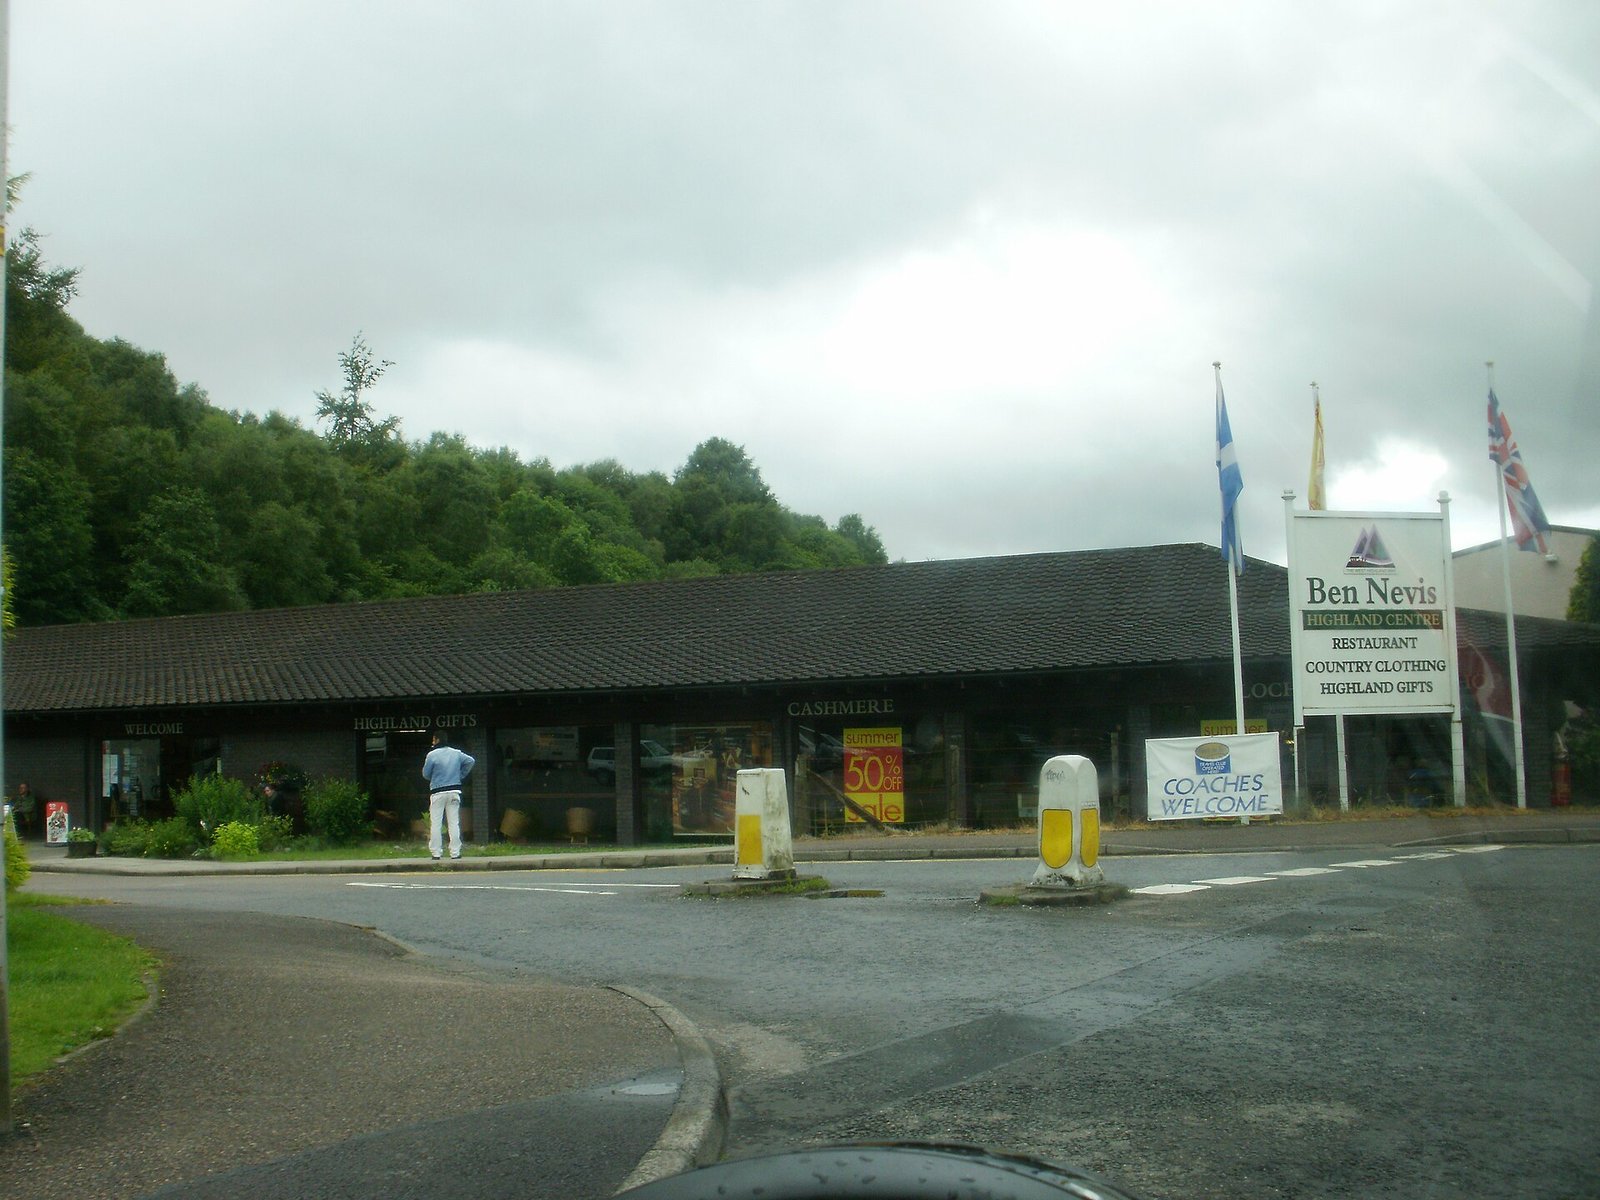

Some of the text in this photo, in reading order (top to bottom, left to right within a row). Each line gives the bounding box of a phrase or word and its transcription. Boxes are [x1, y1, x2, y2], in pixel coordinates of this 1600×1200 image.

[1306, 577, 1437, 605] Ben Nevis
[1307, 613, 1440, 626] HIGHLAND CENTRE
[1332, 637, 1418, 650] RESTAURANT
[1305, 659, 1446, 674] COUNTRY CLOTHING
[1320, 681, 1434, 695] HIGHLAND GIFTS
[787, 699, 894, 716] CASHMERE
[124, 722, 184, 735] WELCOME
[354, 714, 477, 730] HIGHLAND GIFTS
[846, 732, 900, 744] summer
[883, 776, 902, 790] OFF
[1164, 774, 1264, 795] COACHES
[1162, 794, 1269, 815] WELCOME
